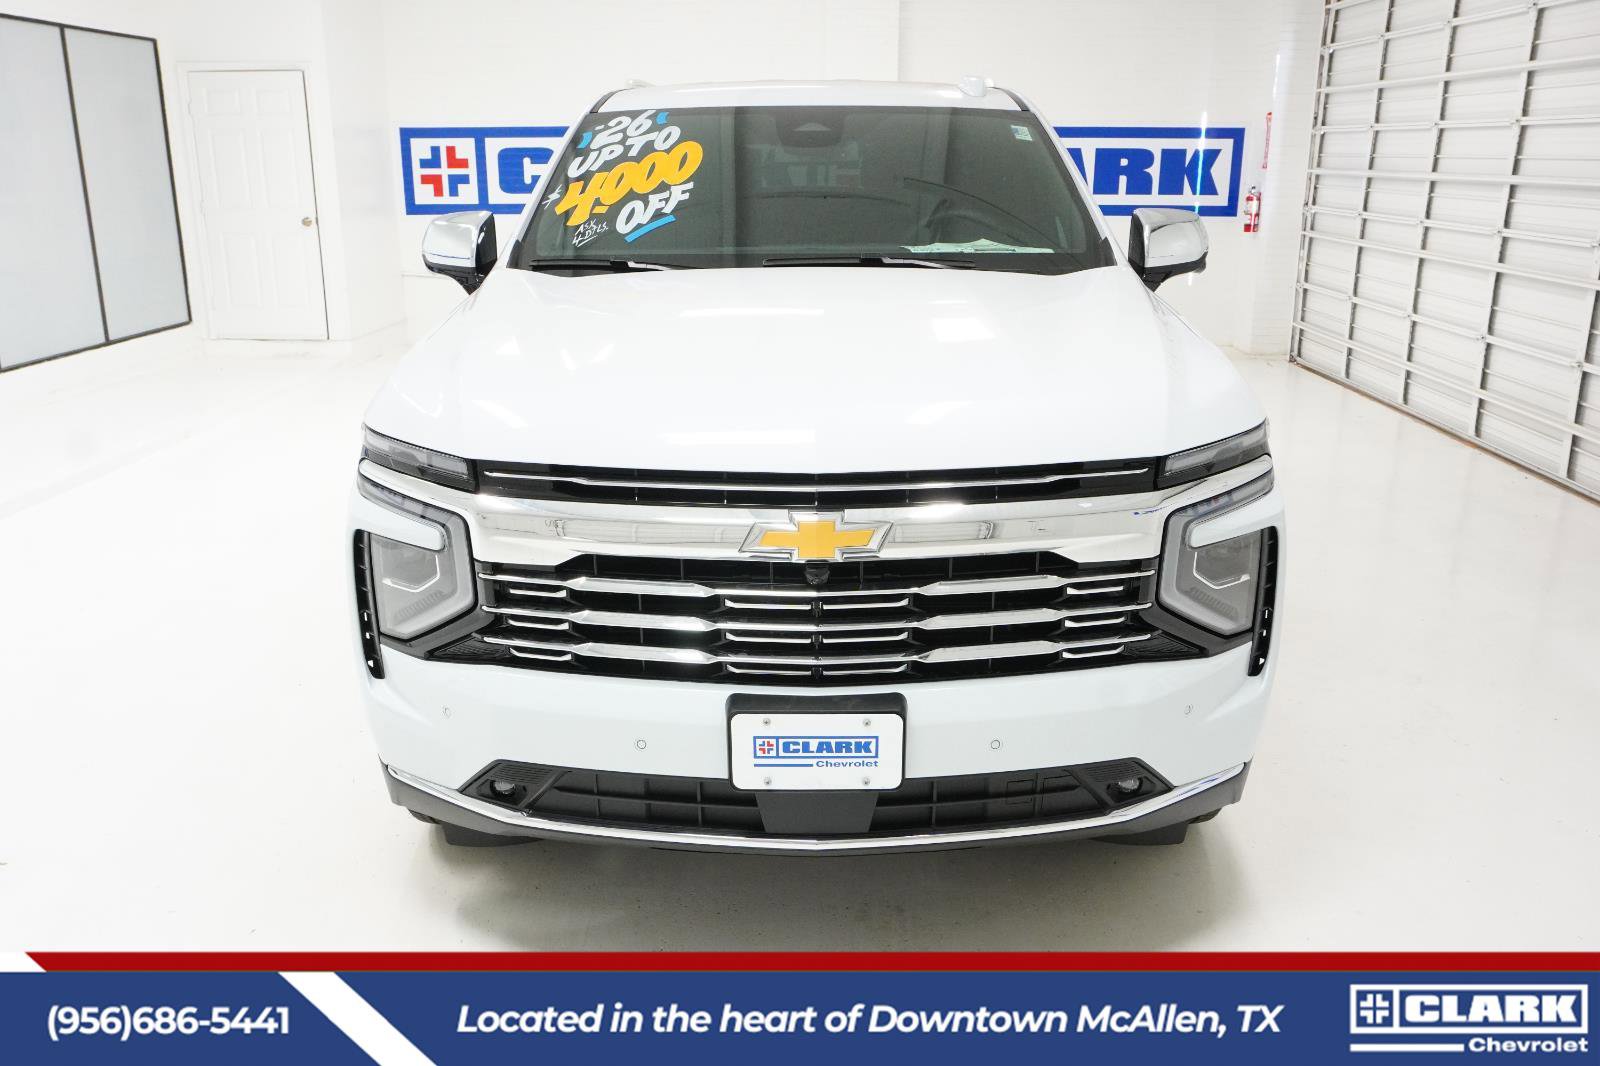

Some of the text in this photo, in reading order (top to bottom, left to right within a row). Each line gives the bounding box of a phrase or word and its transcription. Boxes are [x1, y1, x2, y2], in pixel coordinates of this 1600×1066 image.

[567, 126, 681, 178] UP TO
[616, 181, 694, 234] OFF
[782, 741, 872, 753] CLARK
[816, 760, 878, 768] Chevrolet
